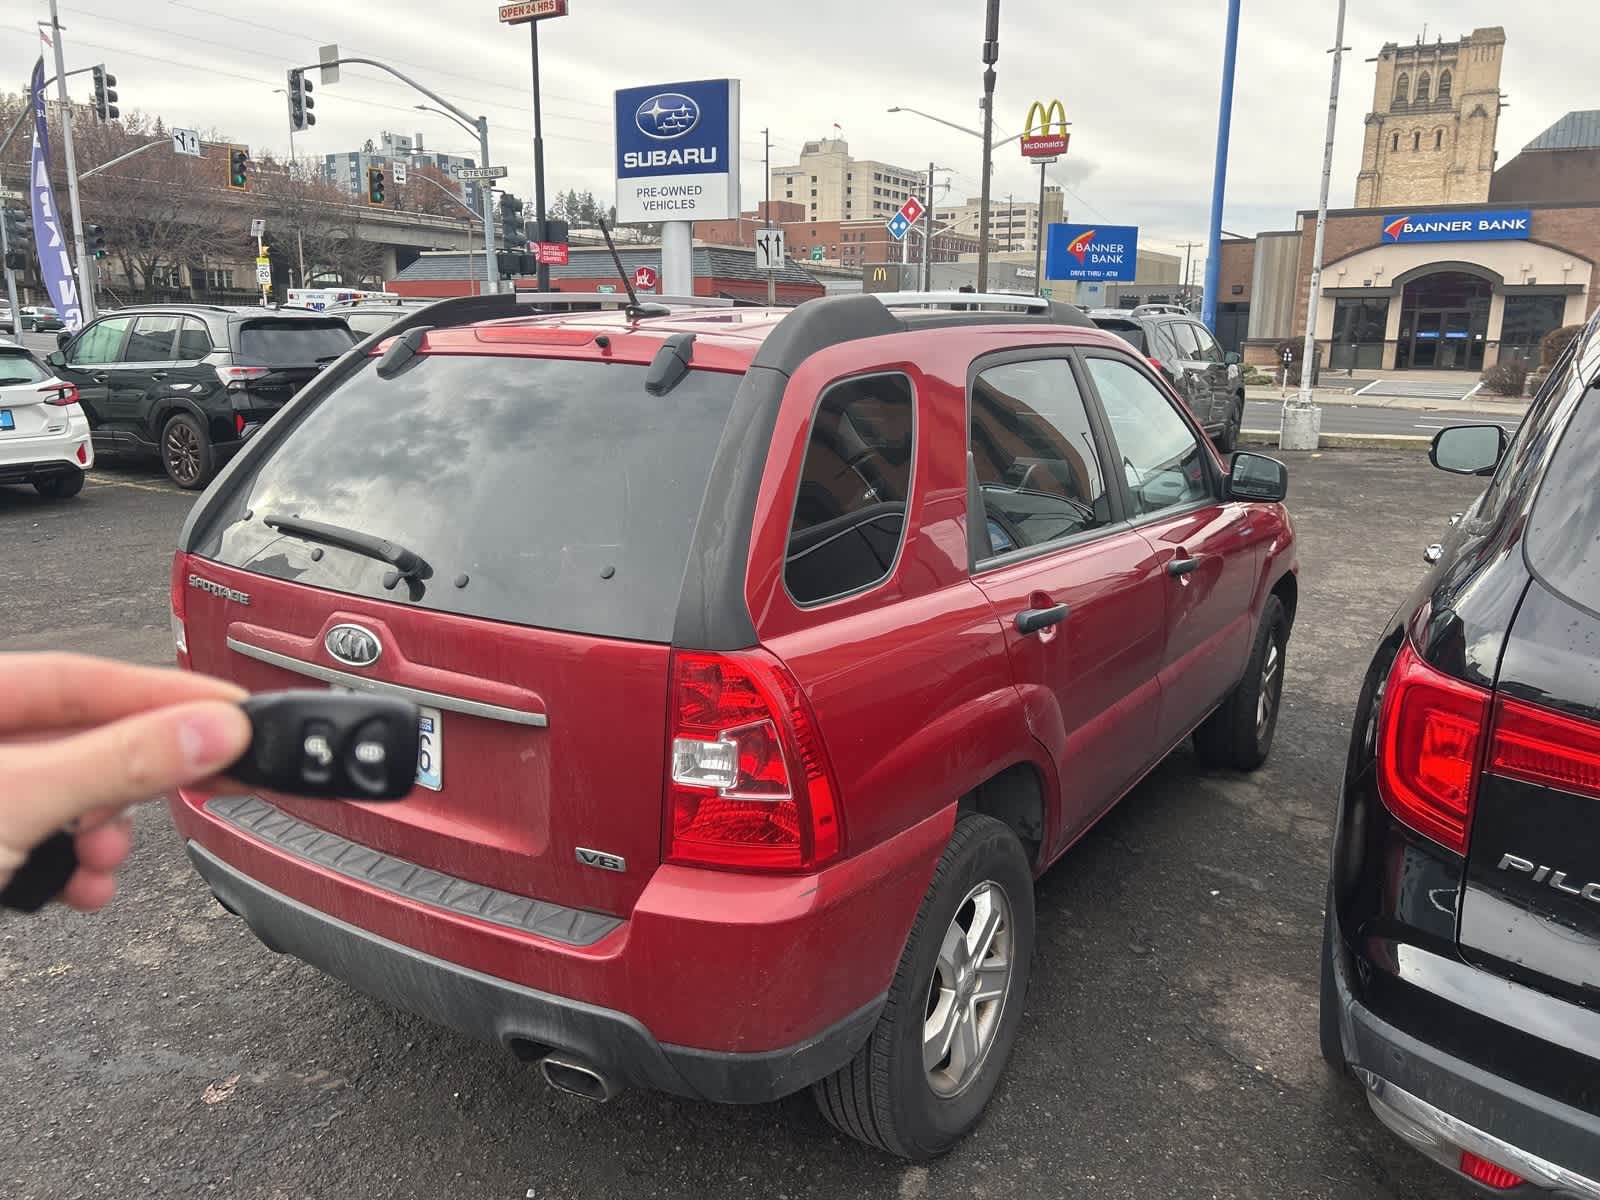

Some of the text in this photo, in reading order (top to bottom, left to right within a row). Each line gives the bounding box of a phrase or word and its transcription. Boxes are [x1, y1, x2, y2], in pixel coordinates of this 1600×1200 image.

[501, 0, 555, 18] OPEN 24 HRS
[623, 146, 717, 169] SUBARU
[636, 185, 703, 198] PRE-OWNED
[642, 199, 696, 211] VEHICLES
[1403, 219, 1527, 233] BANNER BANK
[1075, 242, 1124, 253] BANNER
[1091, 254, 1123, 264] BANK
[260, 270, 270, 278] 20
[188, 573, 249, 605] SPORTAGE
[327, 628, 374, 662] KIA
[579, 850, 620, 870] V6
